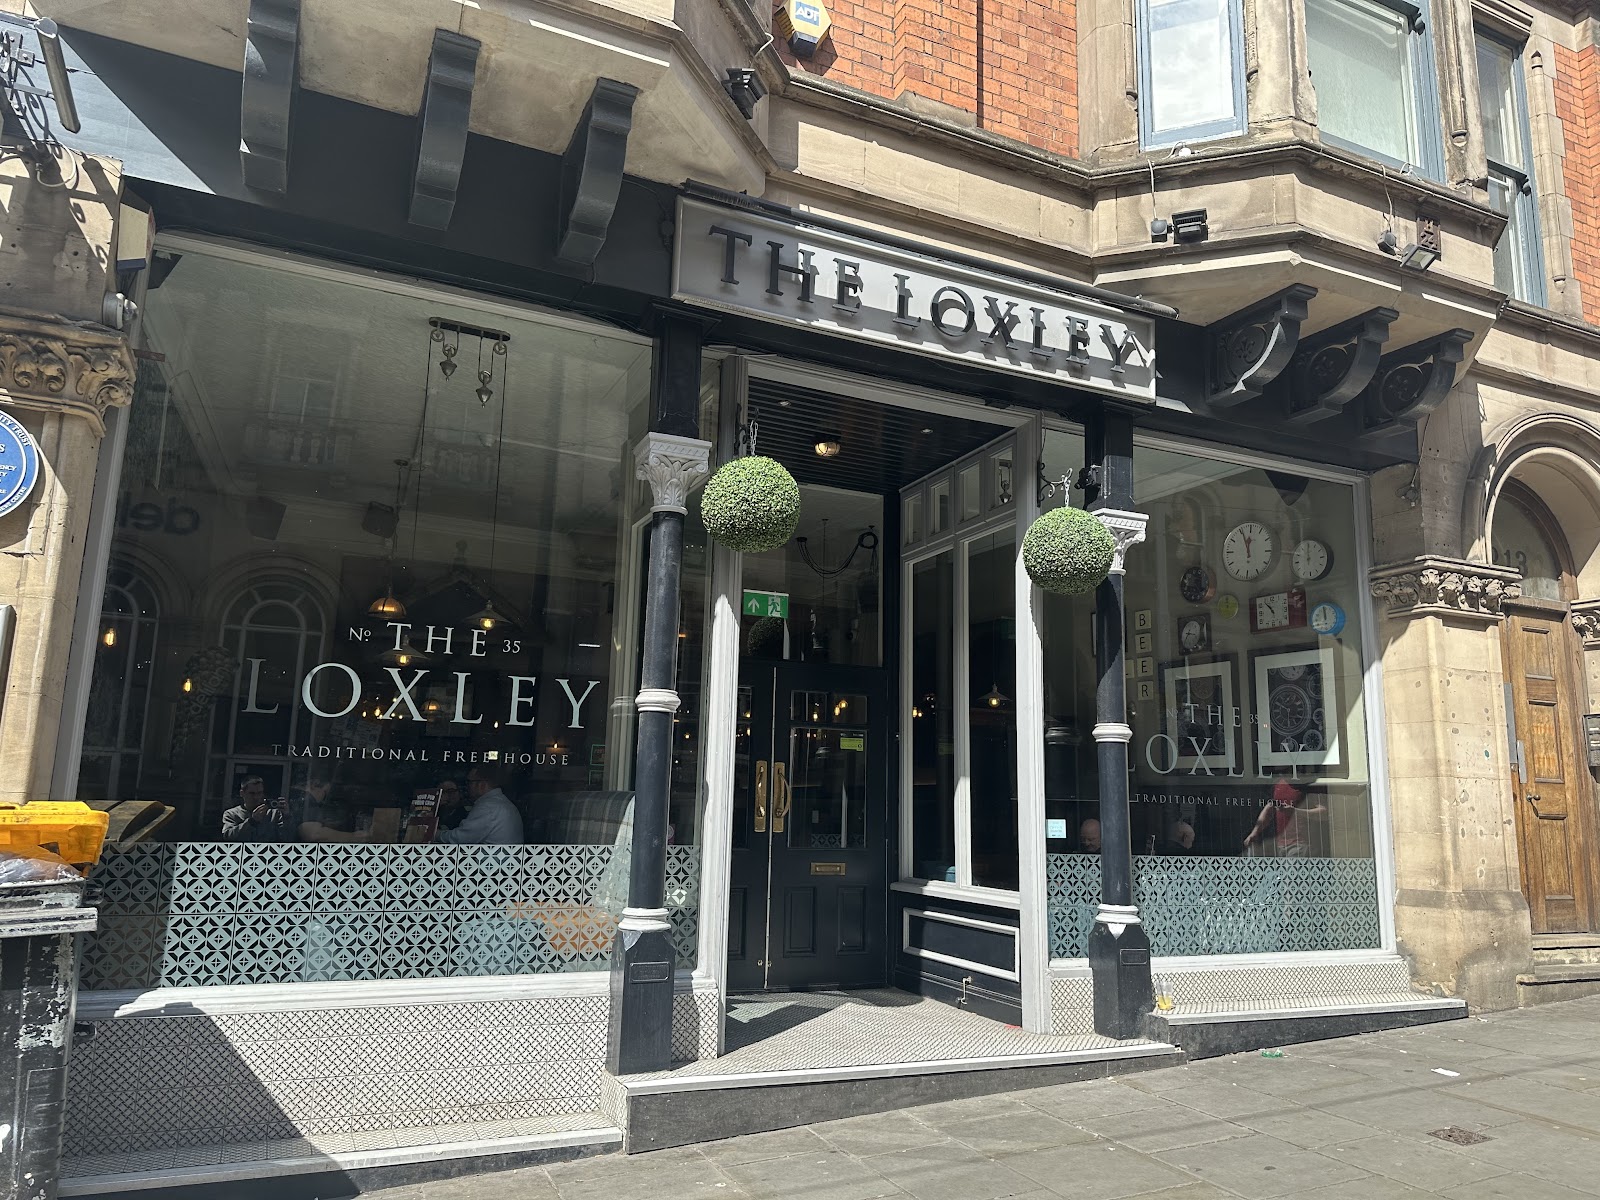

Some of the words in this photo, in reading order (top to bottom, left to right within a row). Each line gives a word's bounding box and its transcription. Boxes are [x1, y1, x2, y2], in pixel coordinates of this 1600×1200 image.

[795, 5, 820, 22] ADT
[708, 224, 864, 317] THE
[891, 272, 1137, 374] LOXLEY
[12, 424, 32, 447] TRUST
[386, 621, 488, 657] THE
[502, 639, 522, 654] 35
[241, 657, 601, 729] LOXLEY
[1183, 702, 1242, 728] THE
[271, 743, 429, 762] TRADITIONAL
[443, 750, 490, 763] FREE
[504, 752, 569, 766] HOUSE
[1134, 793, 1219, 806] TRADITIONAL
[1225, 797, 1252, 807] FREE
[1258, 798, 1296, 809] HOUSE
